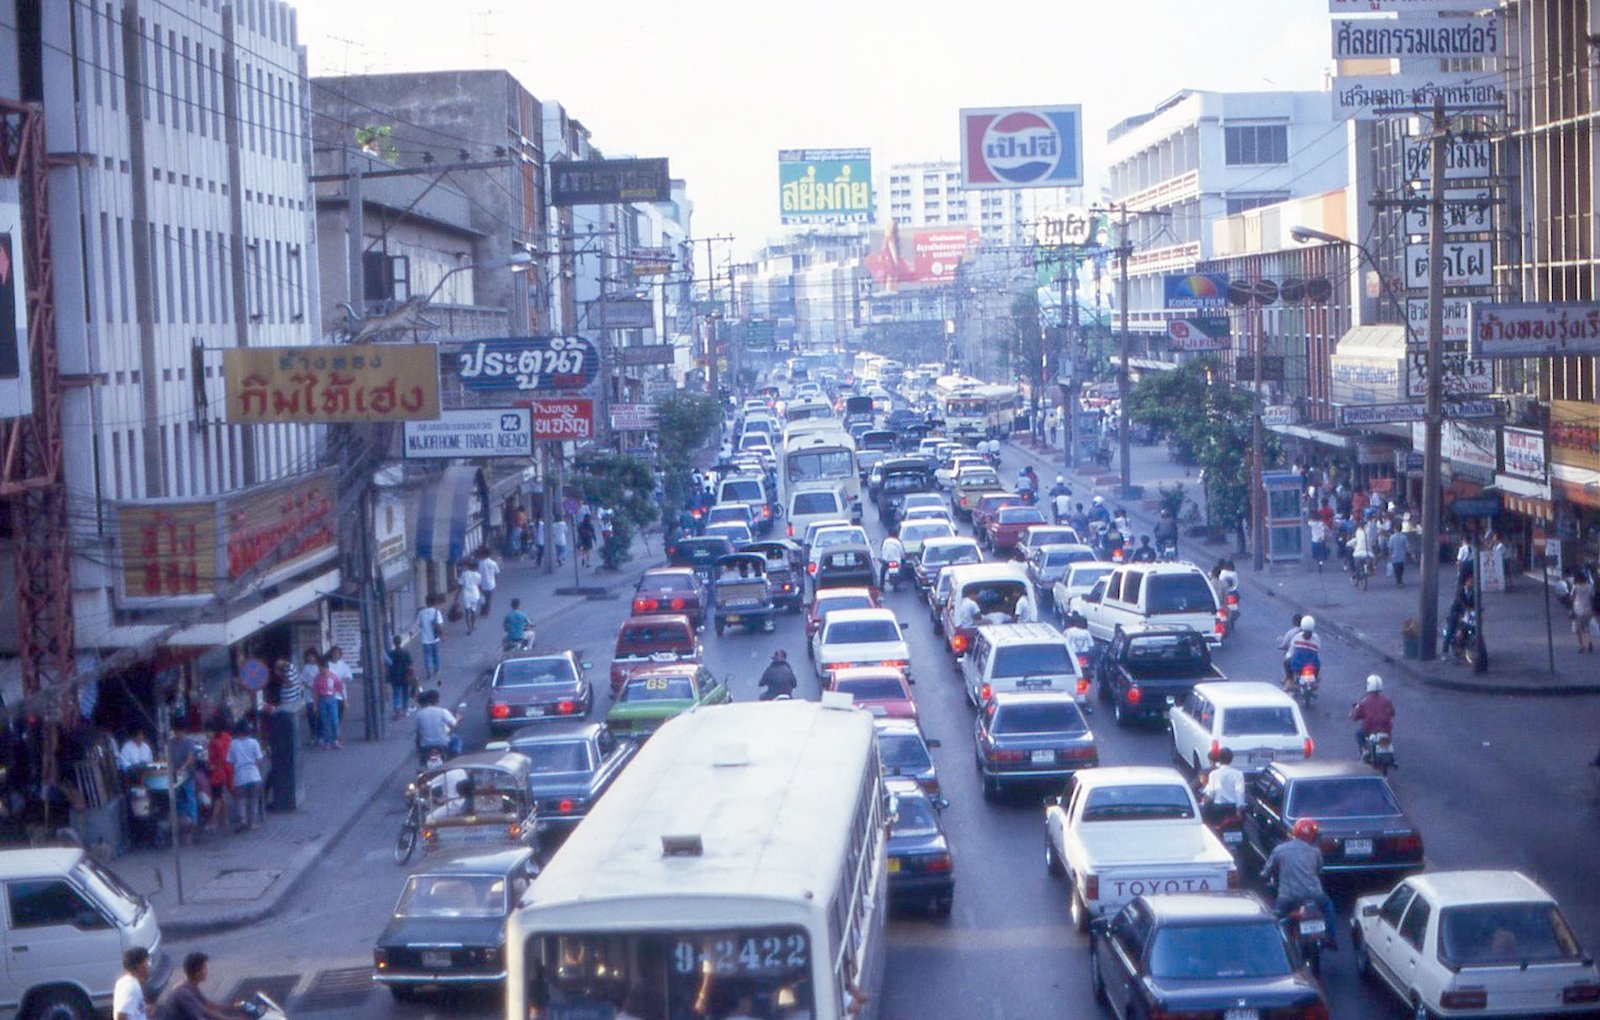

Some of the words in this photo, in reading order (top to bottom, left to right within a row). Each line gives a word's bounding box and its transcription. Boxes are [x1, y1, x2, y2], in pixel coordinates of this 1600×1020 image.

[1337, 19, 1498, 54] ศัลยกรรมเลเซอร์
[986, 132, 1057, 159] เป๊ปซี่
[1168, 297, 1204, 309] Konica
[1205, 296, 1225, 308] FILM
[460, 337, 588, 389] ประตูน้ำ
[465, 433, 494, 448] TRAVEL
[497, 432, 528, 448] AGENCY
[1114, 879, 1210, 896] TOYOTA
